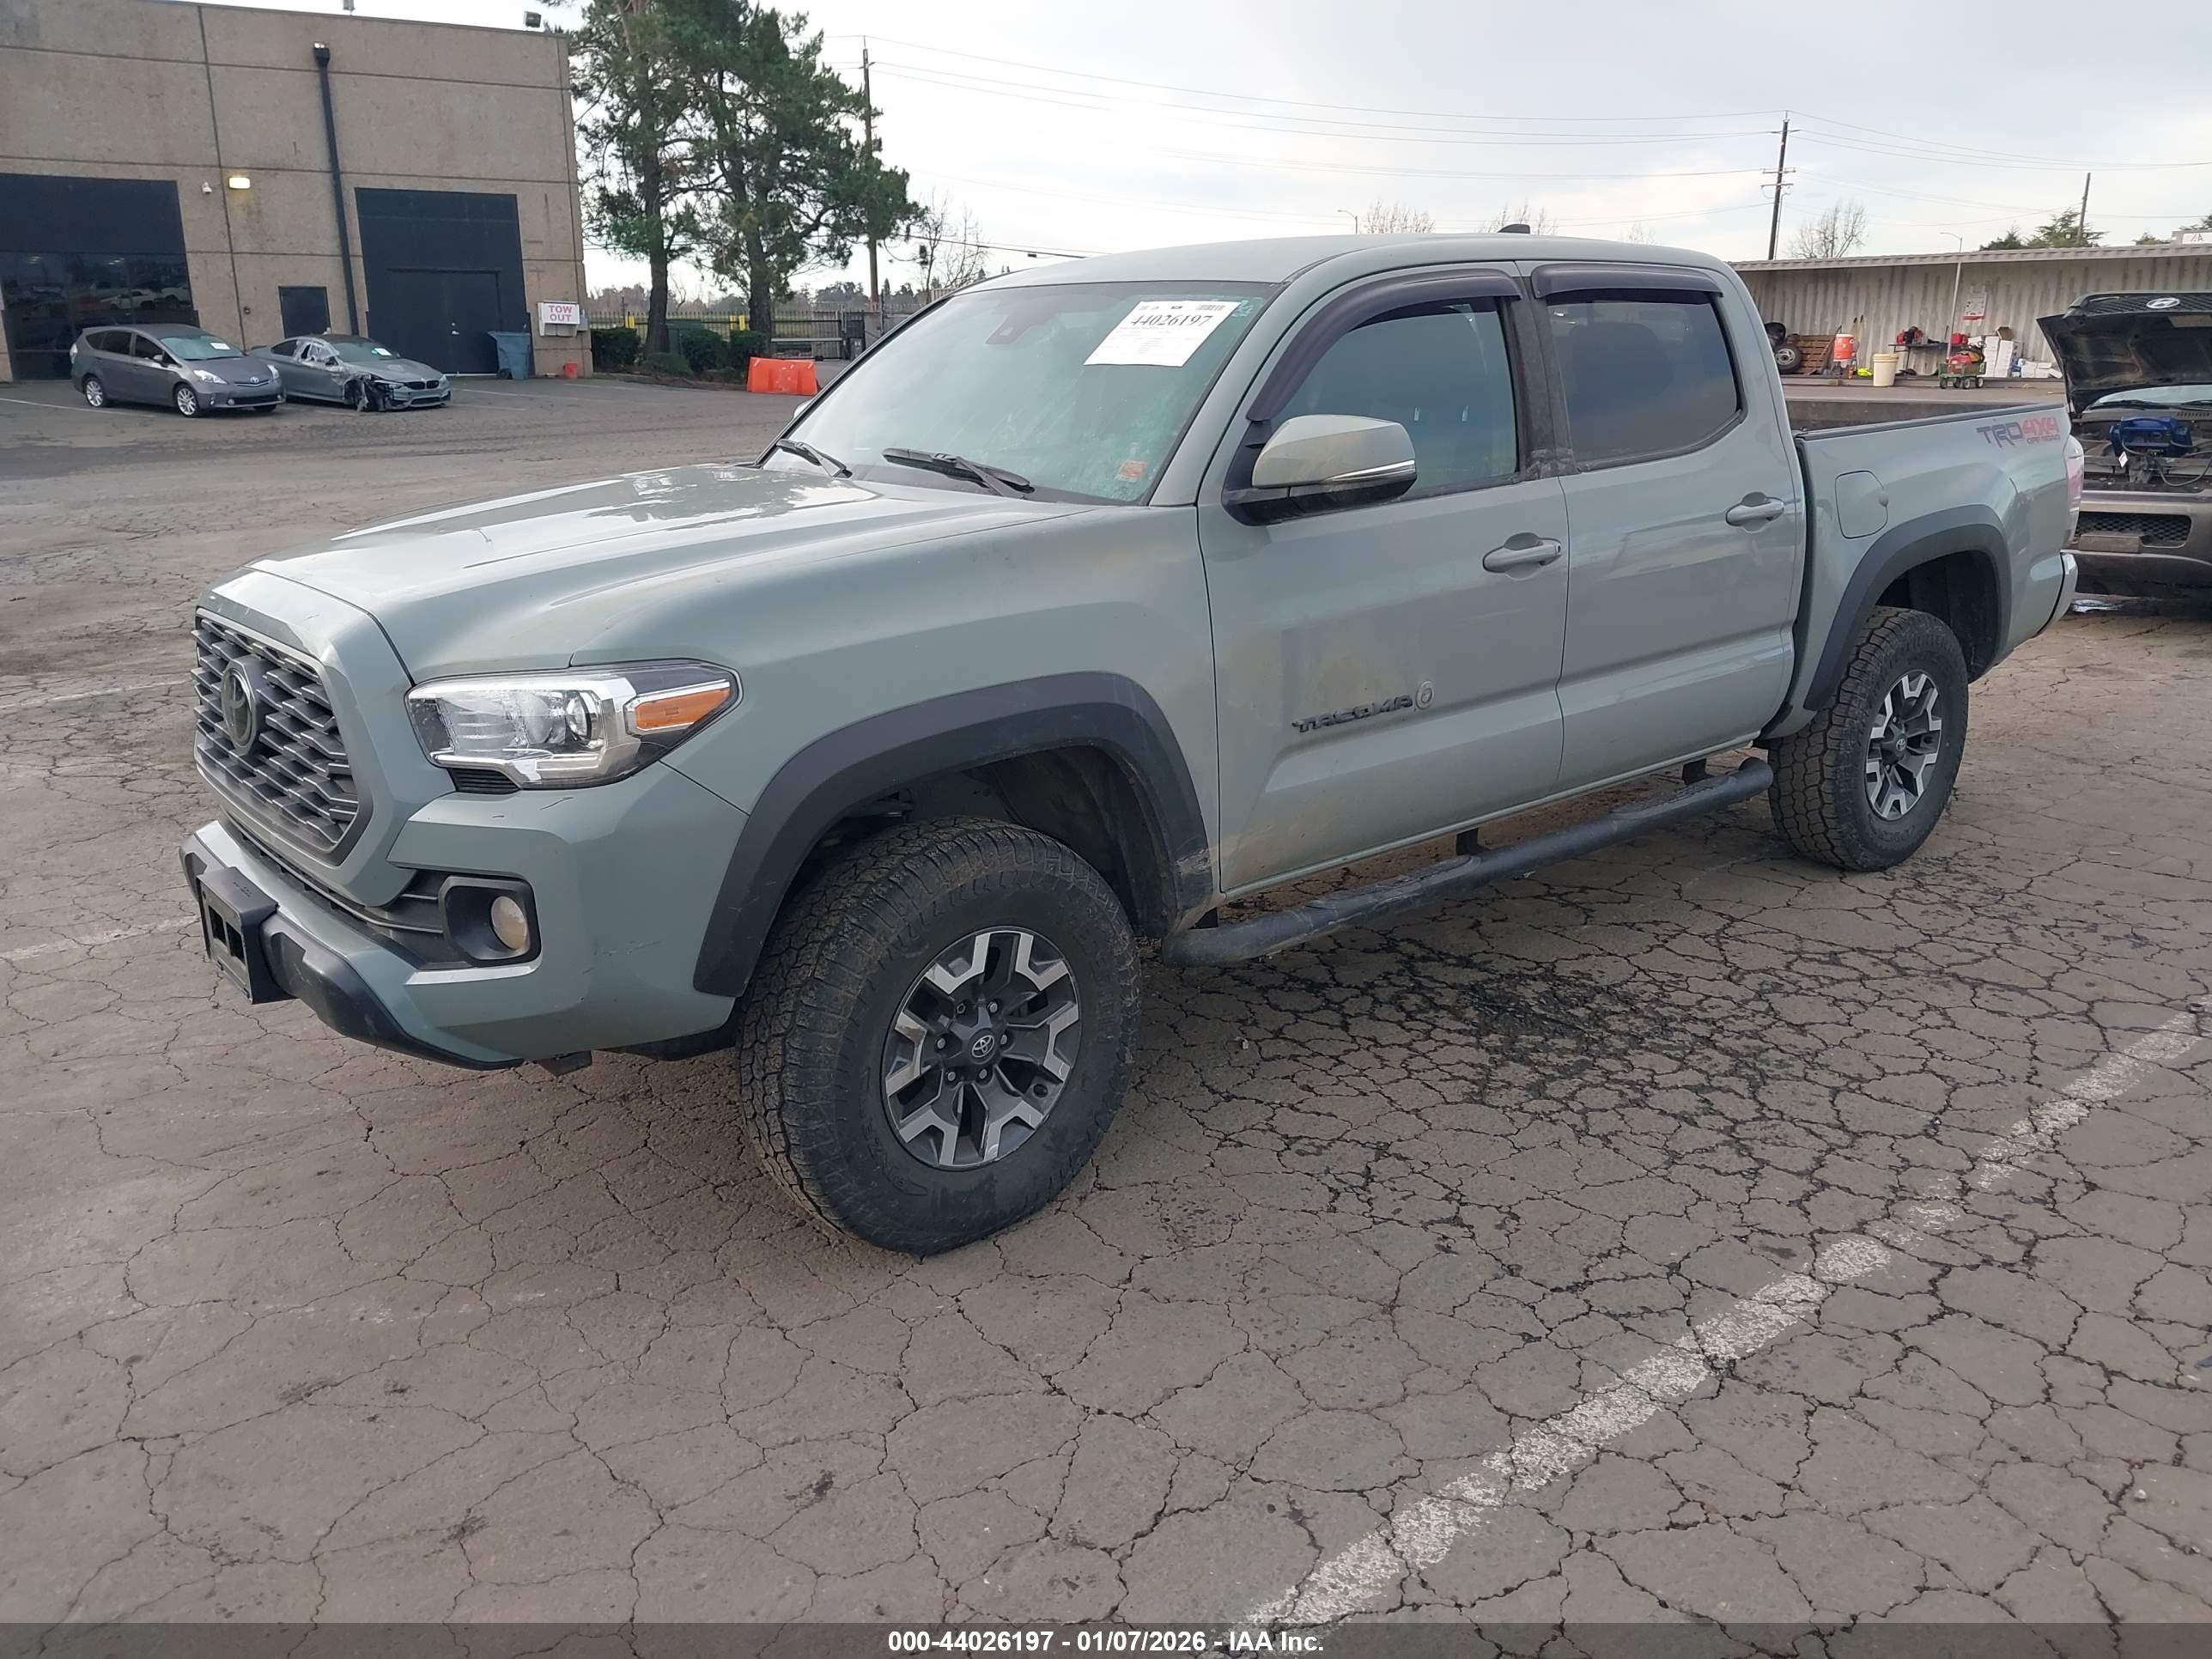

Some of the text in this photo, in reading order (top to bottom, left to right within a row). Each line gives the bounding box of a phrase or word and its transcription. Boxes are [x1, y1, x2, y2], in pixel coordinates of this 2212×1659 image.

[549, 305, 573, 313] TOW
[550, 313, 571, 322] OUT
[1131, 314, 1213, 327] 44026197
[1976, 422, 2023, 447] TRD
[1291, 694, 1413, 733] TACOMA
